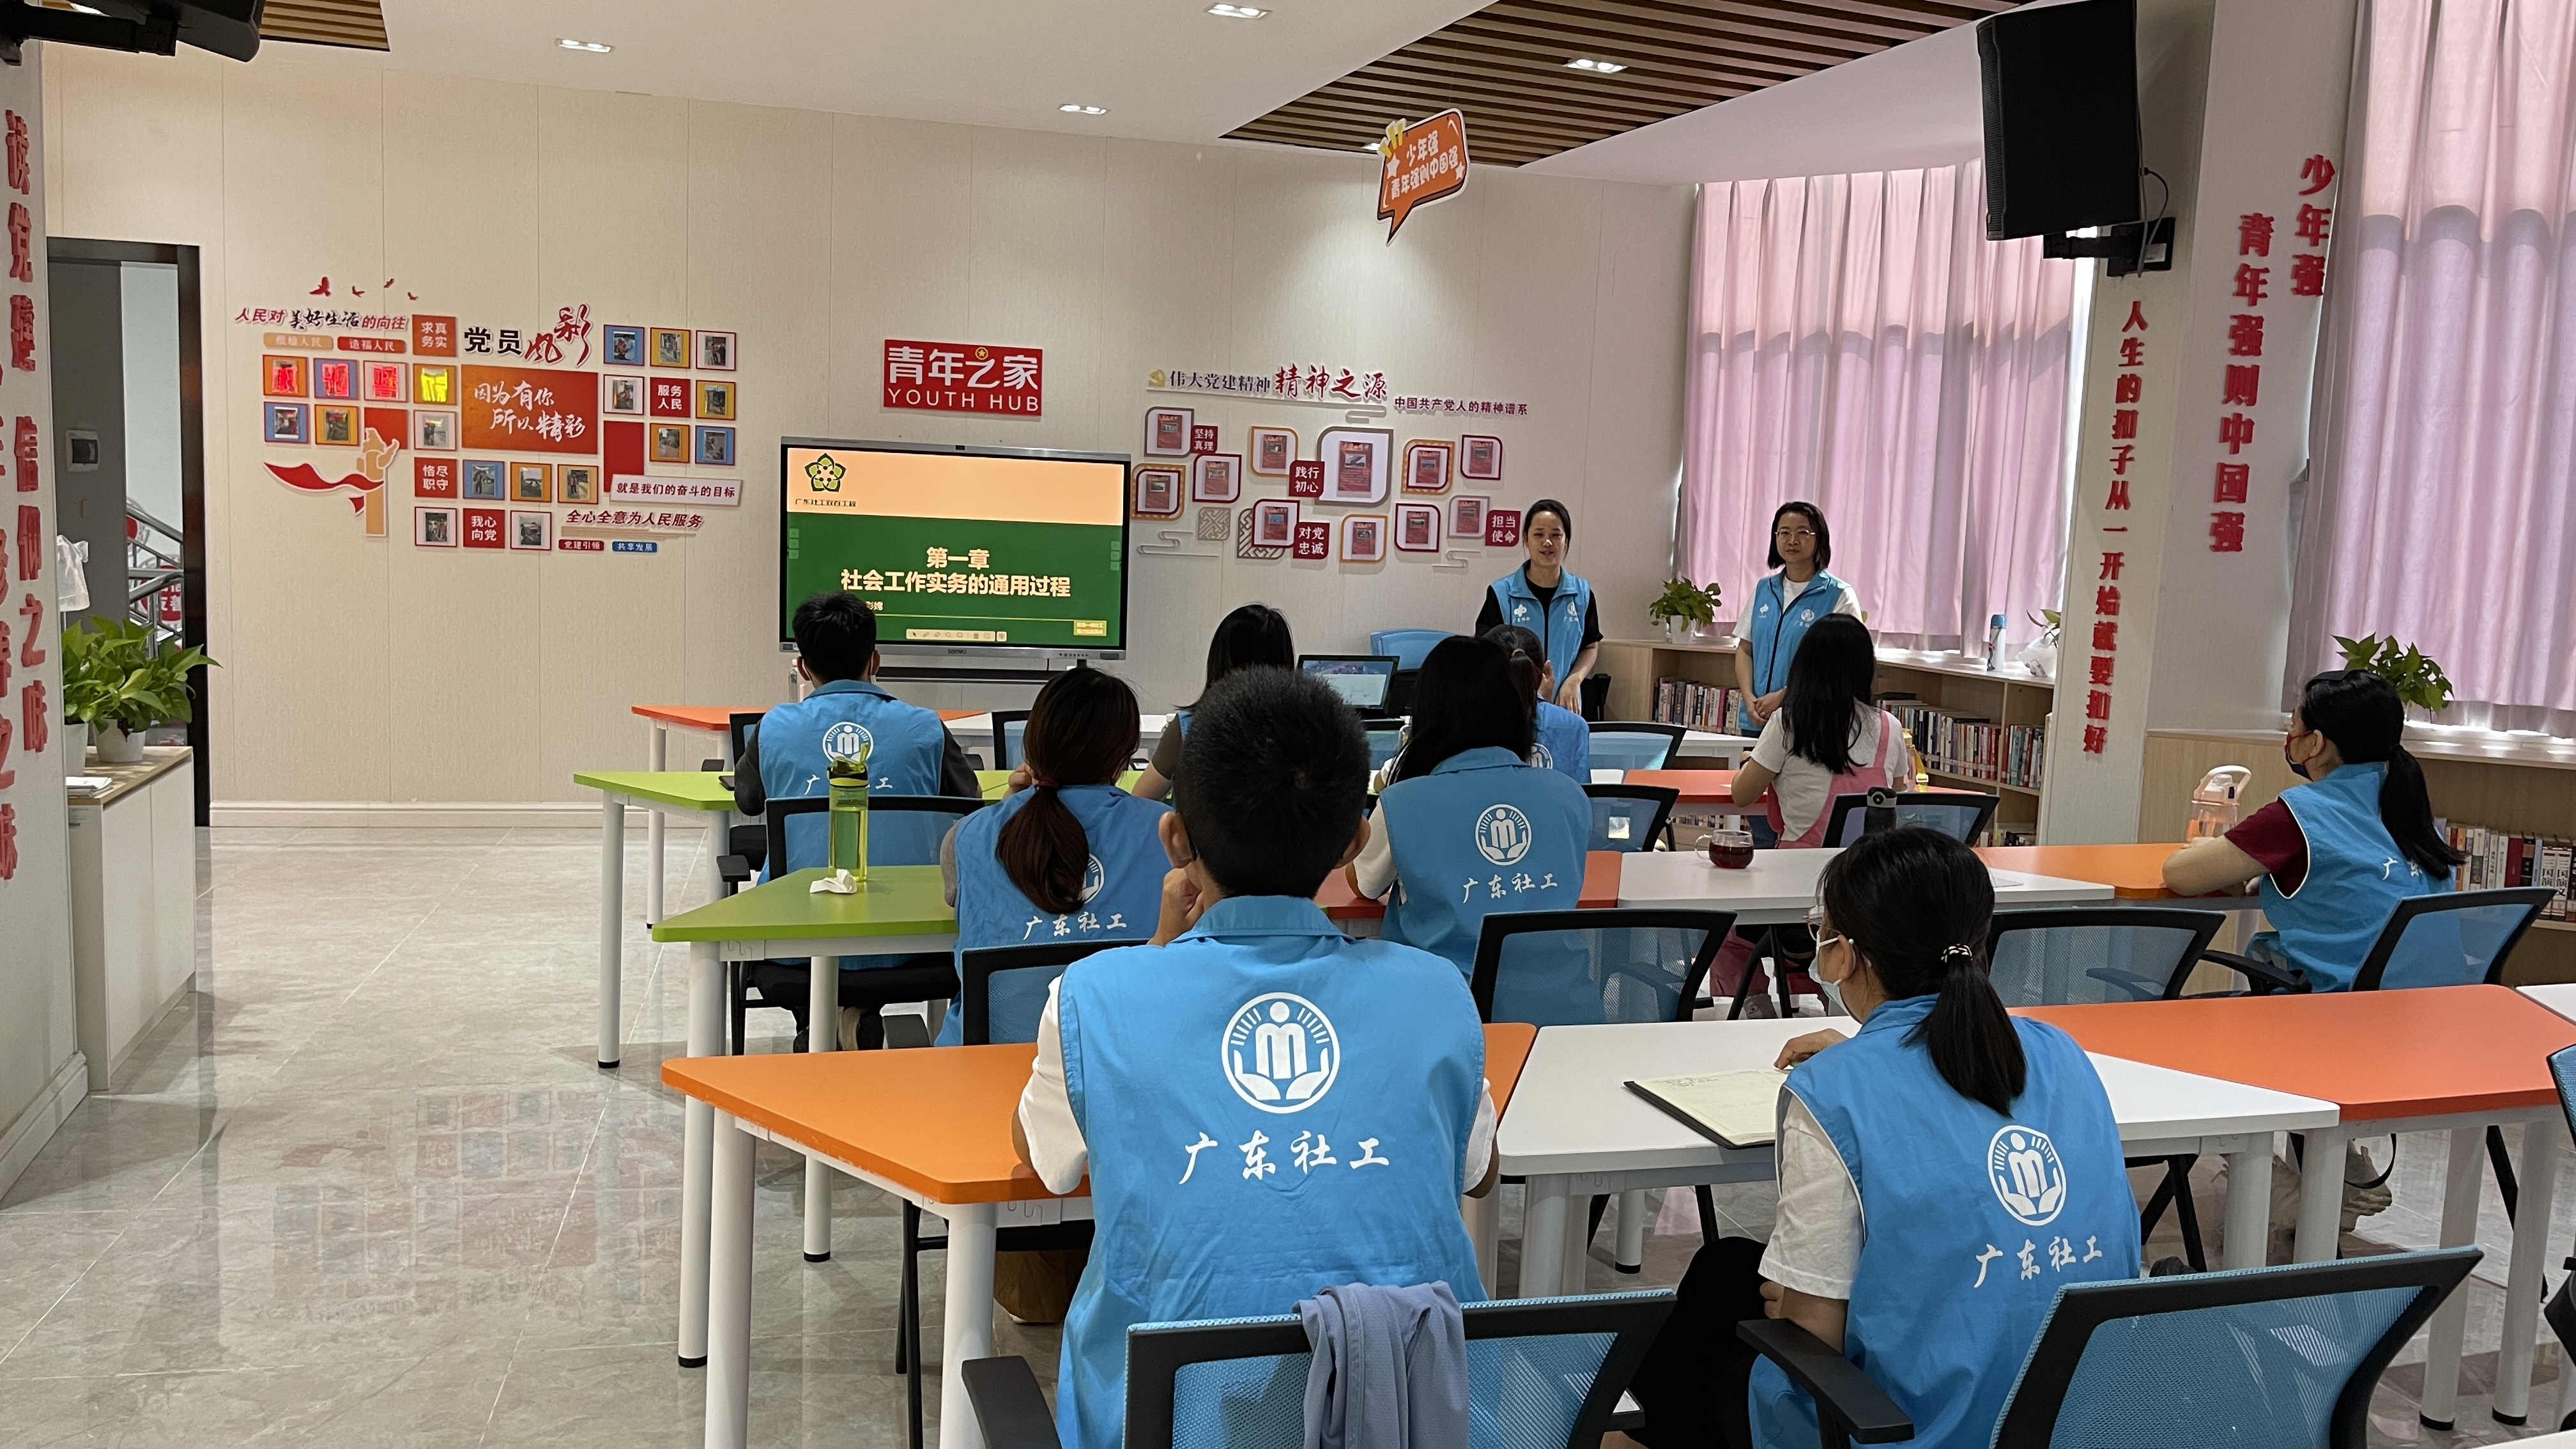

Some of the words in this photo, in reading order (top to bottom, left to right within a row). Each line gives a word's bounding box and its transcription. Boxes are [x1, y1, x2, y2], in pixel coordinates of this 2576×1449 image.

[1406, 130, 1438, 167] 少年强
[1391, 145, 1459, 200] 青年强则中国强
[2290, 154, 2336, 297] 少年强
[236, 308, 407, 330] 人民对美好生活的向往
[421, 321, 447, 334] 求真
[349, 339, 395, 351] 造福人民
[421, 335, 447, 348] 务实
[888, 346, 1038, 390] 青年之家
[1170, 370, 1271, 393] 伟大党建精神
[1275, 362, 1386, 400] 精神之源
[2209, 211, 2274, 553] 青年强则中国强
[473, 380, 555, 411] 因为有你
[657, 385, 682, 397] 服务
[888, 388, 975, 408] YOUTH
[990, 394, 1039, 411] HUB
[657, 397, 682, 410] 人民
[1395, 396, 1528, 415] 中国共产党人的精神谱系
[490, 408, 586, 443] 所以精彩
[1194, 429, 1214, 439] 坚持
[1194, 440, 1214, 451] 真理
[422, 465, 448, 477] 恪尽
[1294, 466, 1319, 479] 践行
[422, 478, 448, 491] 职守
[616, 482, 735, 498] 就是我们的奋斗的目标
[1294, 481, 1319, 493] 初心
[470, 515, 497, 528] 我心
[566, 509, 703, 528] 全心全意为人民服务
[1492, 515, 1516, 528] 担当
[2083, 300, 2149, 754] 人生的扣子从一开始就要扣好
[471, 529, 497, 541] 向党
[1298, 526, 1325, 540] 对党
[1492, 530, 1516, 544] 使命
[564, 540, 601, 550] 党建引领
[617, 542, 654, 552] 共享发展
[1298, 542, 1324, 555] 忠诚
[926, 546, 990, 571] 第一章
[840, 569, 1071, 597] 社会工作实务的通用过程
[2541, 858, 2555, 887] 三国演
[1462, 873, 1558, 904] 广东社工
[1023, 911, 1128, 941] 广东社工
[1178, 1129, 1390, 1185] 广东社工
[1973, 1235, 2103, 1289] 广东社工
